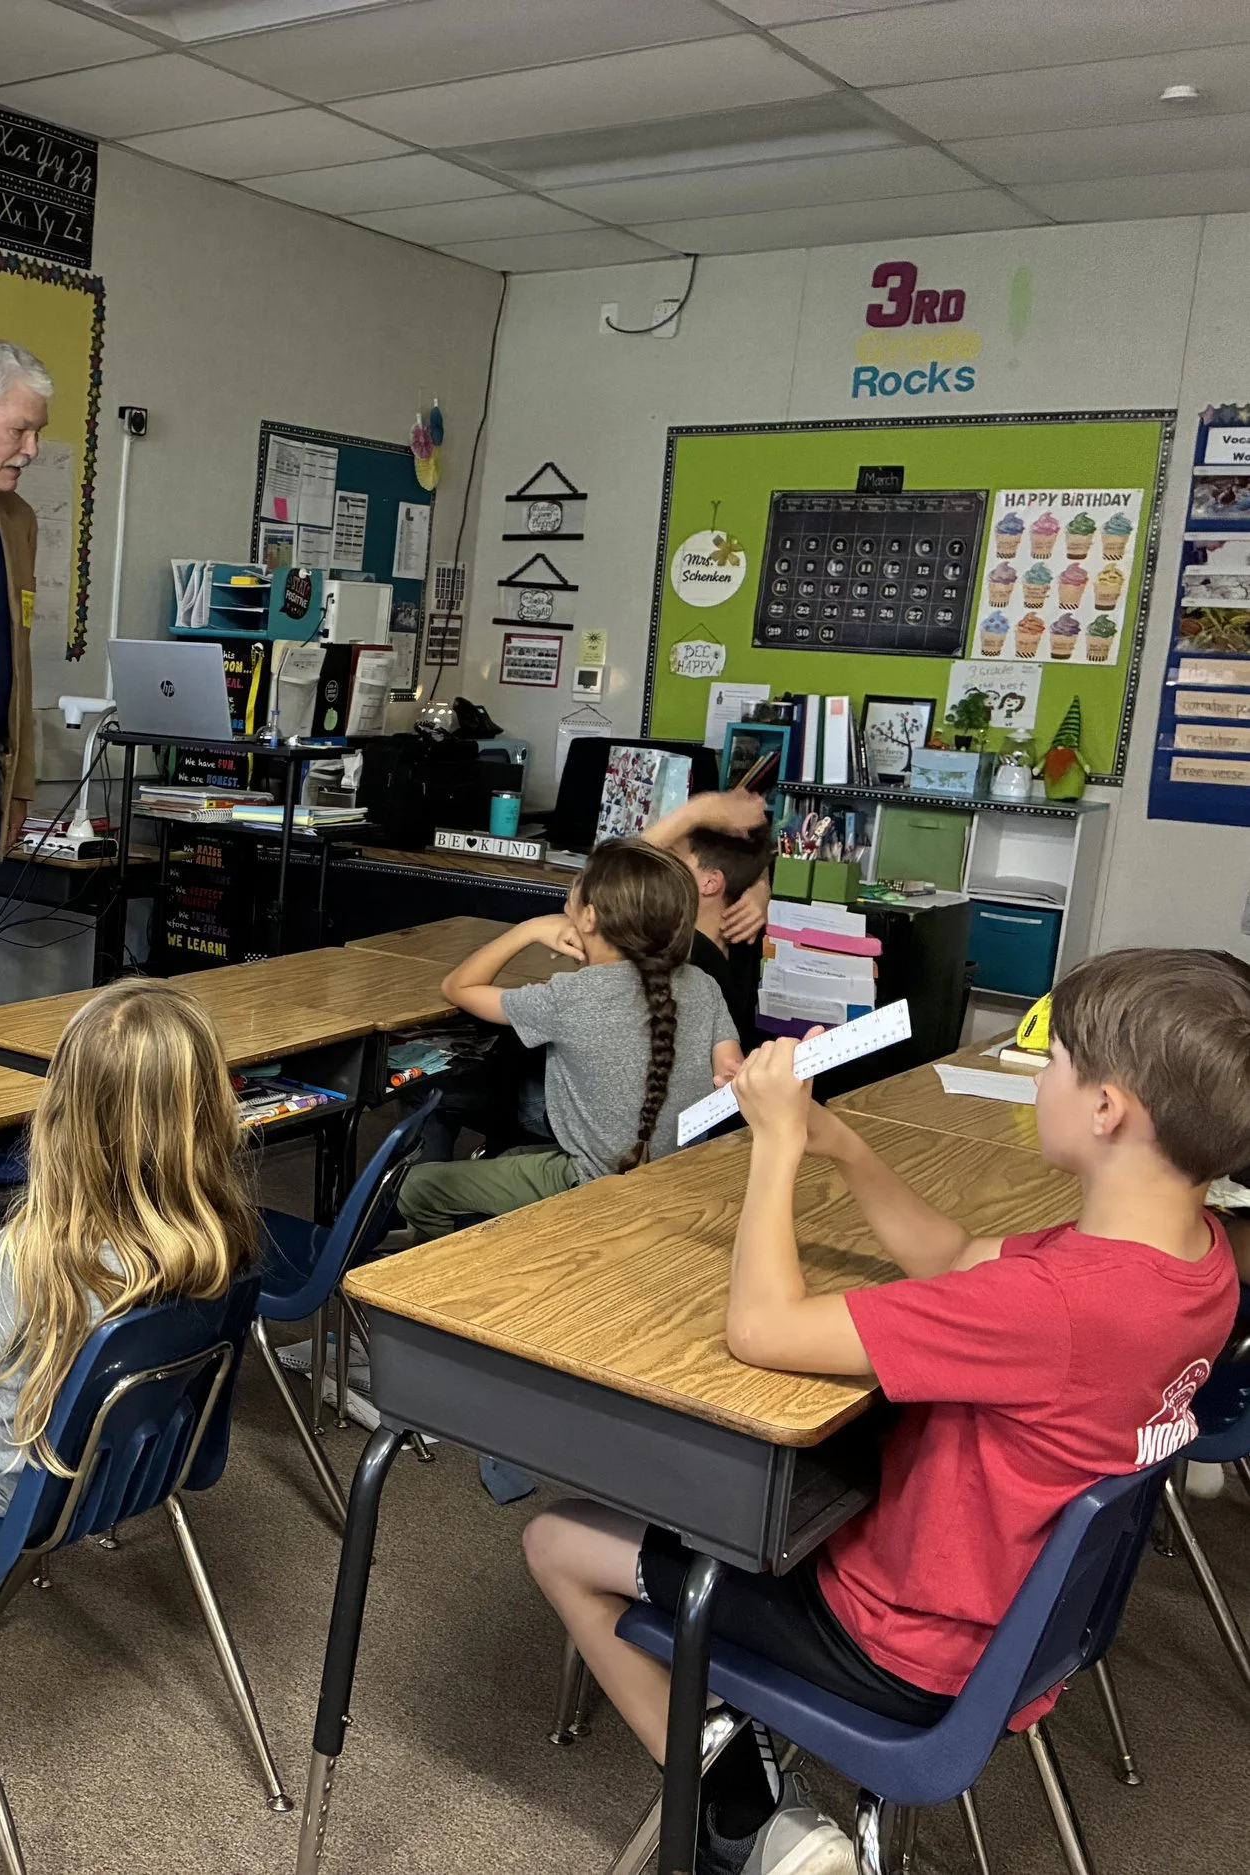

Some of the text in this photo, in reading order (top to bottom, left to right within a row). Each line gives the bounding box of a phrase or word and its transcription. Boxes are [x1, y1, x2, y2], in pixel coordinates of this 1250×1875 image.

[36, 137, 65, 181] Yy
[68, 151, 94, 194] Zz
[35, 205, 55, 246] Yy
[64, 211, 84, 243] Zz
[866, 261, 966, 328] 3RD
[851, 361, 976, 398] Rocks
[864, 473, 899, 488] March
[1004, 492, 1058, 508] HAPPY
[683, 553, 714, 567] Mrs.
[681, 570, 732, 583] Schenken
[830, 562, 844, 572] 10
[860, 564, 872, 573] 11
[886, 564, 900, 574] 12
[917, 566, 930, 575] 13
[947, 566, 960, 576] 14
[776, 583, 957, 598] 15 16 17 18 19 20 21
[285, 590, 309, 608] POSITIVE
[770, 604, 952, 621] 22 23 24 25 26 27 28
[768, 627, 834, 638] 29 30 31
[684, 644, 712, 659] BEE
[677, 660, 716, 674] HAPPY
[160, 680, 175, 698] hp
[185, 757, 236, 771] We have FUN.
[178, 772, 189, 782] We
[206, 774, 240, 788] HONEST.
[183, 844, 223, 857] We RAISE
[437, 833, 537, 857] BE KIND
[175, 886, 187, 895] We
[178, 911, 190, 920] We
[166, 919, 188, 930] efore
[167, 932, 227, 957] WE LEARN!
